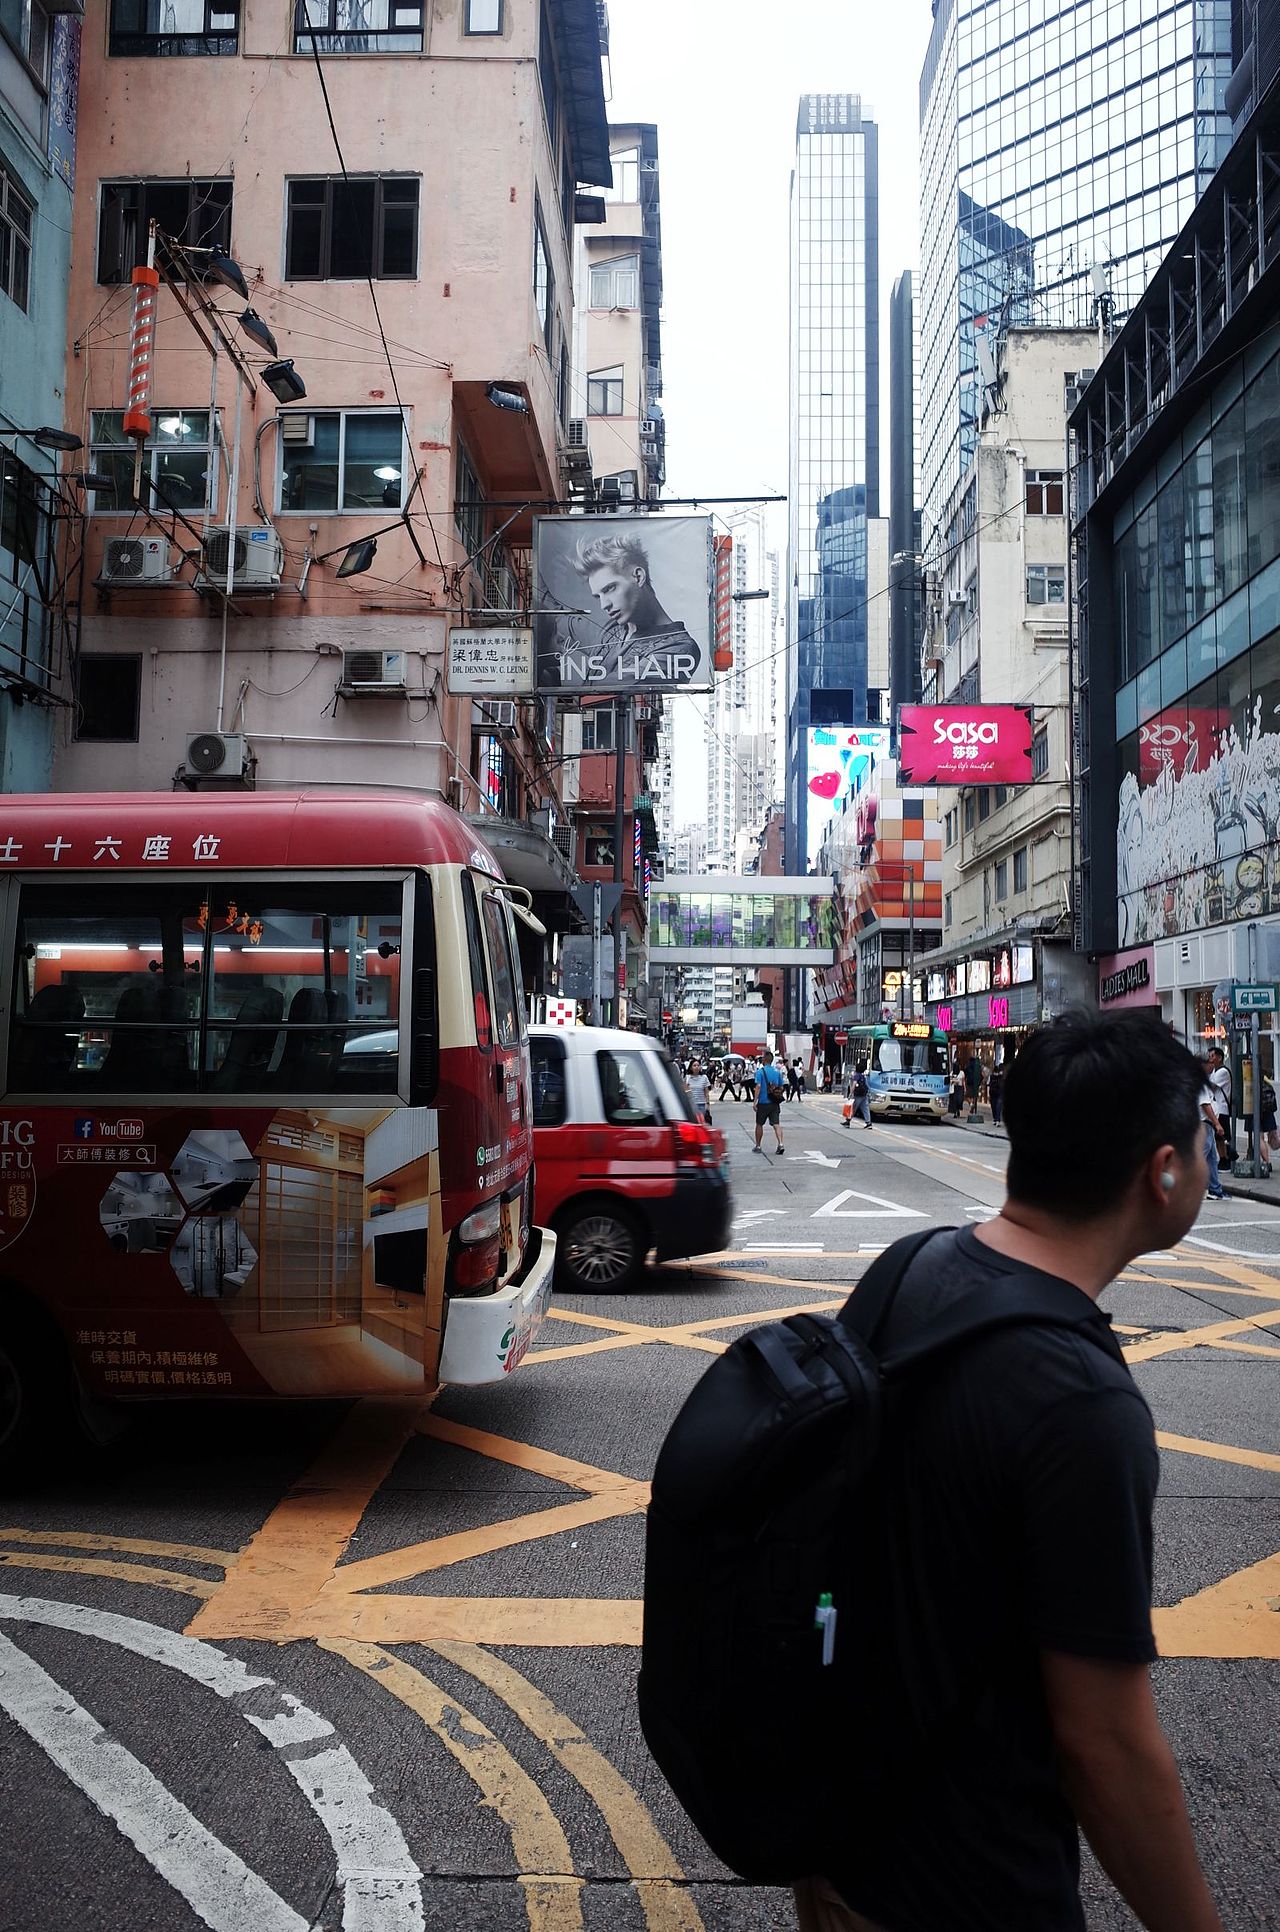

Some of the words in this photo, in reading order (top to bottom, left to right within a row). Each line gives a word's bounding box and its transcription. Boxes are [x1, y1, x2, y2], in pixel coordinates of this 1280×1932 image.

[464, 666, 489, 674] DENNIS
[506, 666, 529, 674] LEUNG
[560, 655, 607, 681] INS
[617, 654, 696, 681] HAIR
[933, 718, 998, 744] Sasa
[1101, 970, 1125, 1000] LADIES
[1126, 961, 1148, 988] MALL
[99, 1121, 142, 1137] YouTube
